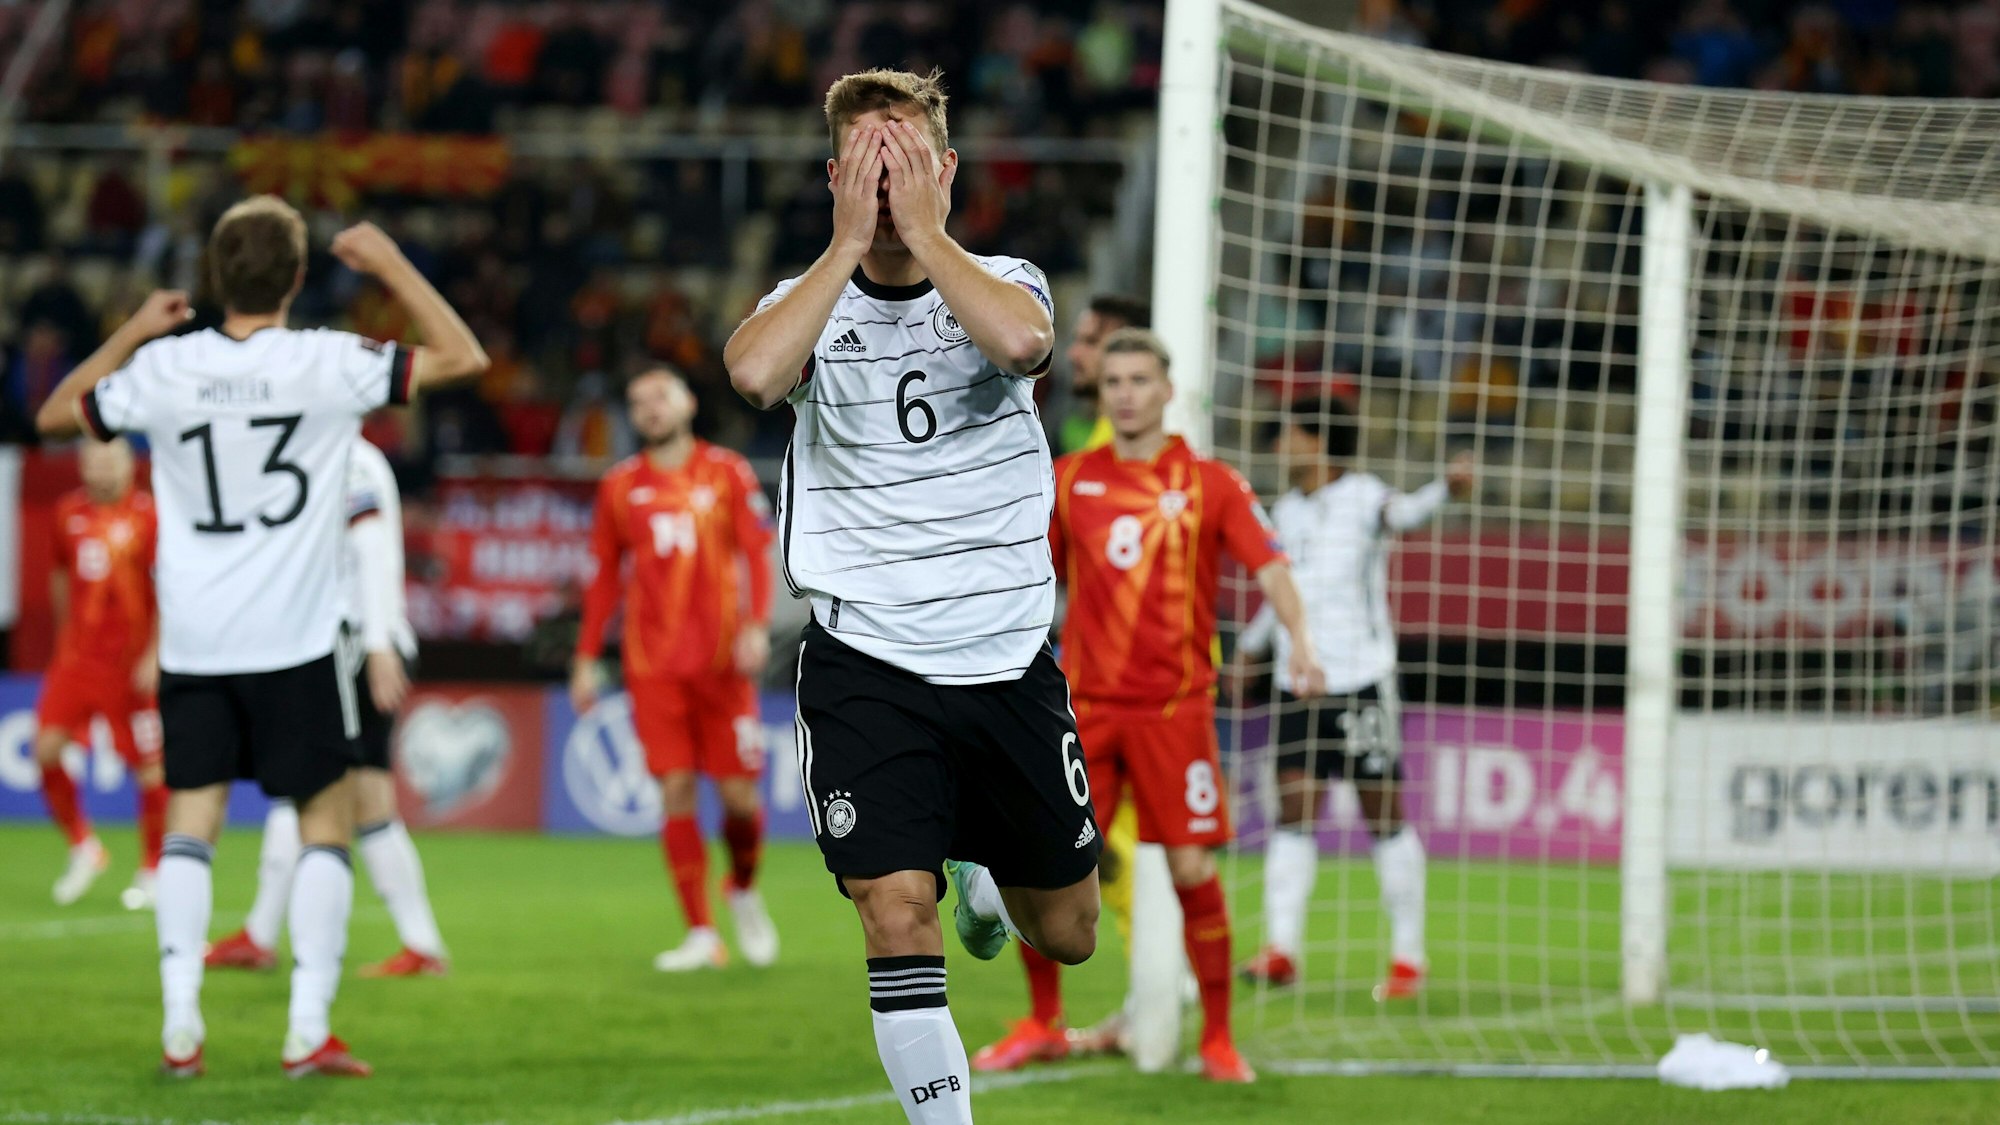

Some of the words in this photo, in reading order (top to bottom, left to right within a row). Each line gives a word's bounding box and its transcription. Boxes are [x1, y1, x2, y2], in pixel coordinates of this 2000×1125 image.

[829, 343, 867, 353] adidas
[896, 369, 937, 444] 6
[179, 411, 309, 534] 13
[1105, 514, 1143, 571] 8
[1061, 731, 1090, 807] 6
[1185, 758, 1219, 816] 8
[1432, 744, 1622, 832] ID.4
[1730, 763, 2000, 844] goren
[1074, 829, 1097, 849] adidas
[910, 1075, 961, 1105] DFB
